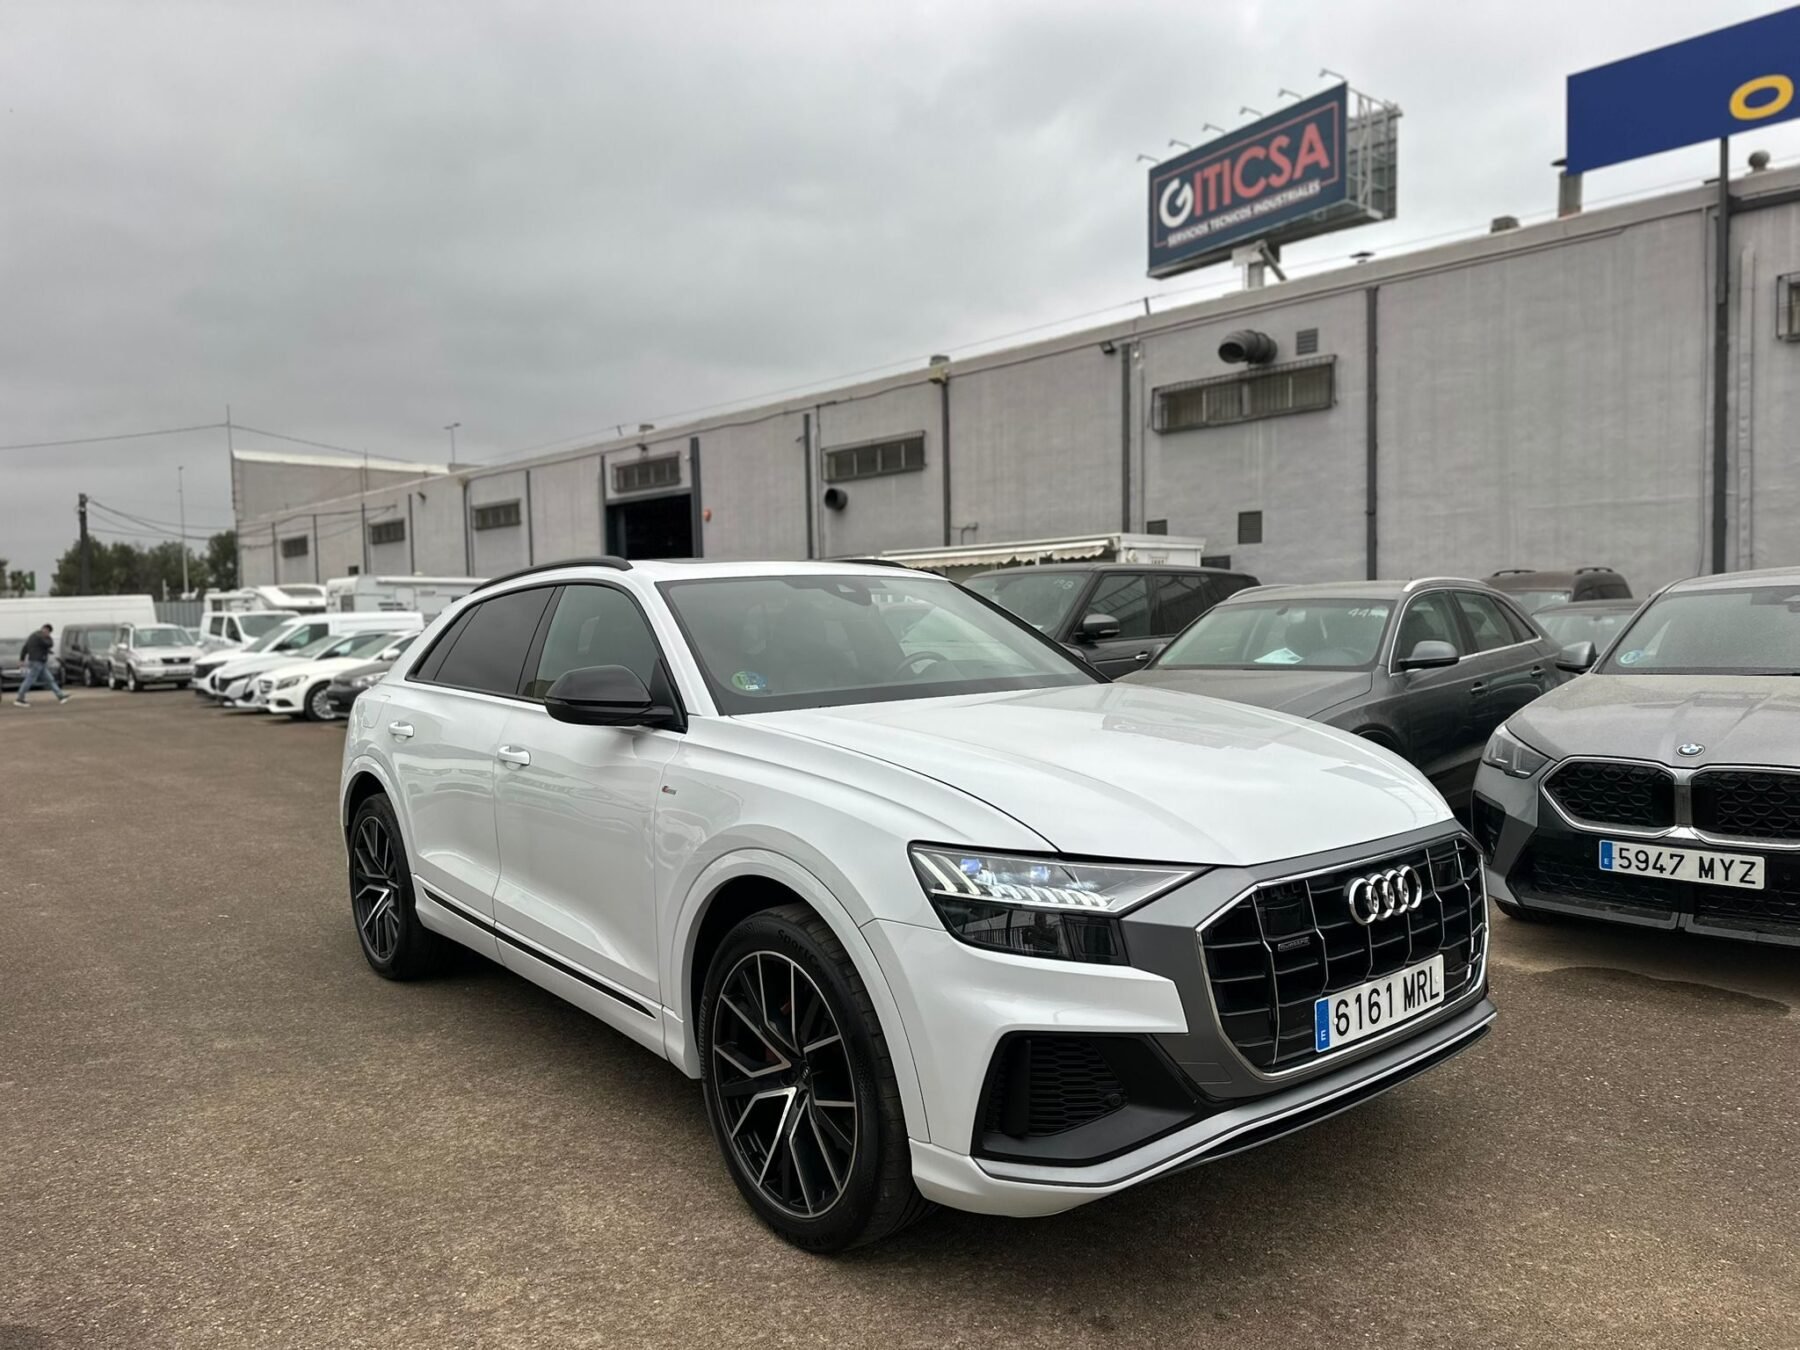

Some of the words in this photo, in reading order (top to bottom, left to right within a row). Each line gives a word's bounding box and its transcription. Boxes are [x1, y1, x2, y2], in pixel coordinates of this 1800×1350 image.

[1159, 122, 1330, 228] GITICSA
[1618, 847, 1685, 876] 5947
[1698, 856, 1757, 885] MYZ
[1335, 982, 1393, 1037] 6161
[1403, 965, 1440, 1012] MRL
